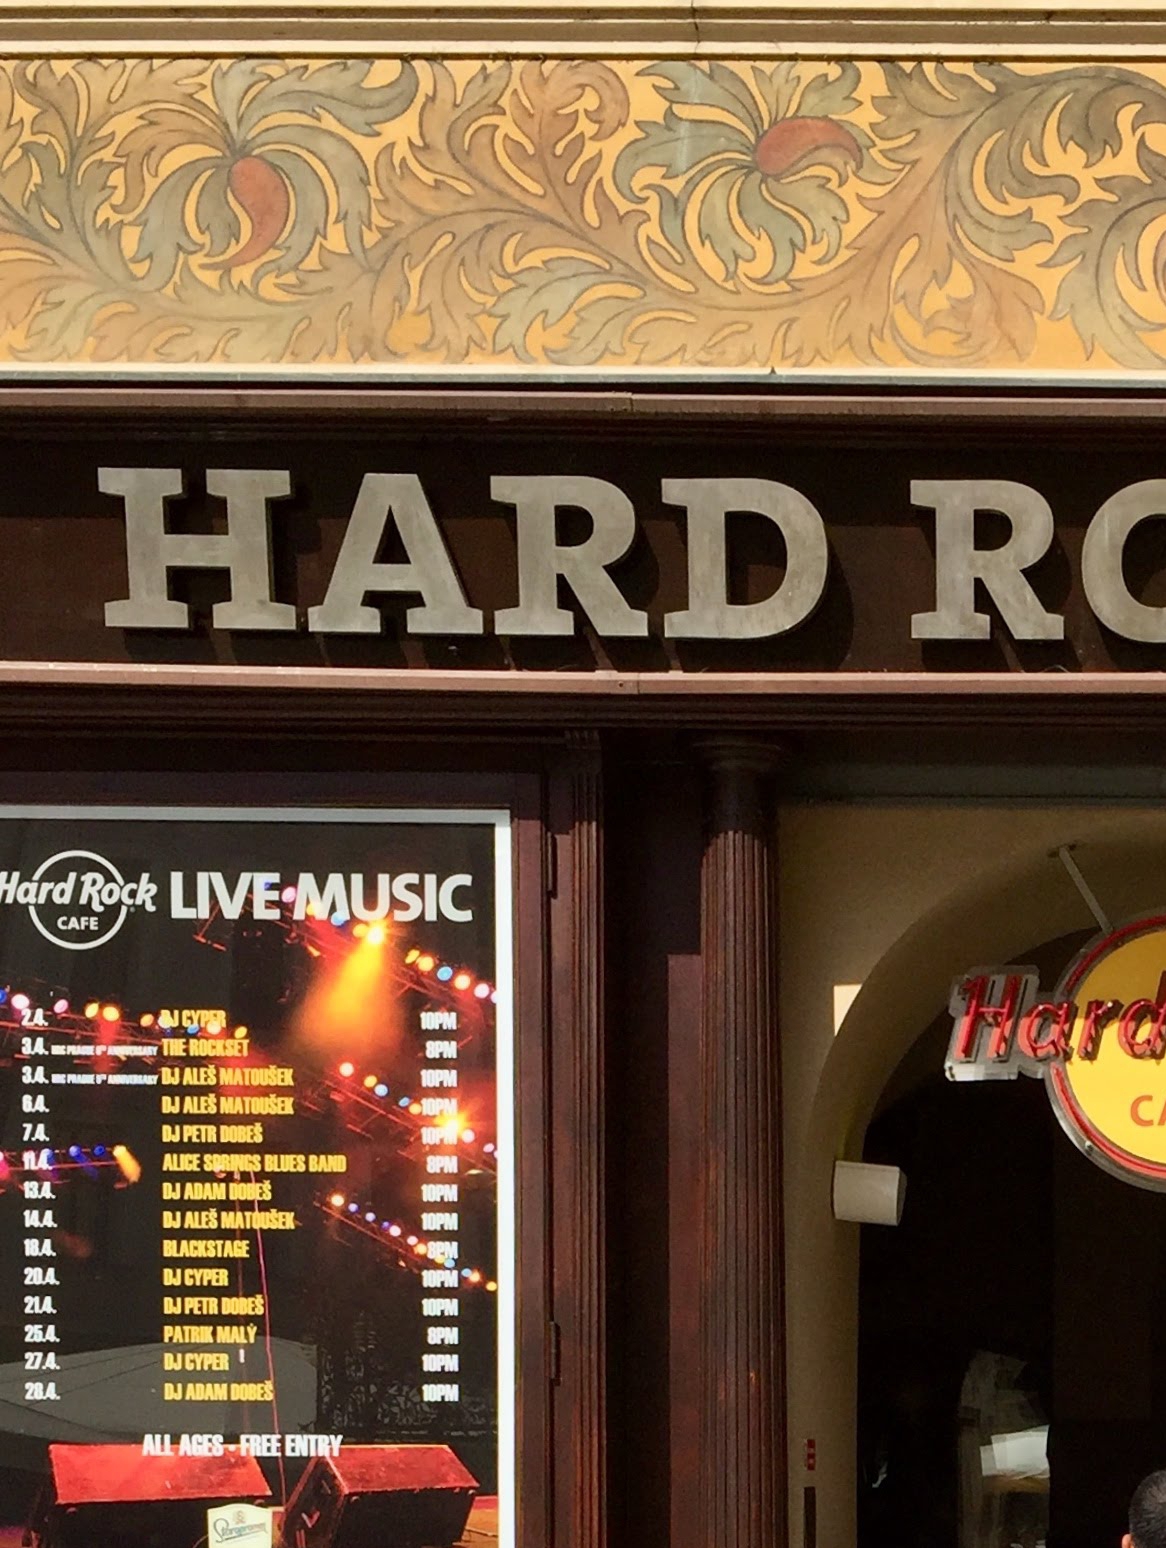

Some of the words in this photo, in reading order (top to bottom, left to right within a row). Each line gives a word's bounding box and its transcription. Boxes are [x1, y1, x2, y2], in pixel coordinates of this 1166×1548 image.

[97, 466, 831, 639] HARD
[0, 871, 77, 904] Hard
[79, 872, 158, 912] Rock
[170, 871, 280, 919] LIVE
[294, 872, 473, 922] MUSIC
[56, 916, 99, 931] CAFE
[21, 1008, 48, 1027] 2.4.
[160, 1010, 179, 1027] DJ
[182, 1010, 226, 1027] CYPER
[420, 1012, 457, 1030] 10PM
[22, 1037, 48, 1055] 3.4.
[162, 1039, 187, 1057] THE
[189, 1039, 249, 1057] ROCKSET
[425, 1041, 458, 1059] 8PM
[22, 1066, 48, 1084] 3.4.
[161, 1067, 180, 1085] DJ
[420, 1069, 458, 1087] 10PM
[22, 1094, 49, 1113] 6.4.
[161, 1096, 180, 1114] DJ
[421, 1098, 458, 1116] 10PM
[22, 1123, 49, 1141] 7.4.
[161, 1125, 180, 1142] DJ
[183, 1125, 217, 1143] PETR
[421, 1127, 458, 1145] 10PM
[163, 1154, 200, 1171] ALICE
[265, 1155, 306, 1172] BLUES
[308, 1155, 347, 1172] BAND
[426, 1155, 459, 1173] 8PM
[23, 1181, 56, 1199] 13.4.
[162, 1183, 181, 1200] DJ
[184, 1183, 226, 1200] ADAM
[421, 1184, 458, 1202] 10PM
[23, 1210, 57, 1228] 14.4.
[163, 1211, 181, 1229] DJ
[421, 1212, 459, 1231] 10PM
[23, 1238, 56, 1257] 18.4.
[163, 1240, 250, 1258] BLACKSTAGE
[426, 1241, 459, 1260] 8PM
[23, 1267, 60, 1285] 20.4.
[163, 1268, 181, 1286] DJ
[184, 1269, 228, 1286] CYPER
[421, 1269, 459, 1288] 10PM
[24, 1296, 57, 1314] 21.4.
[163, 1297, 181, 1314] DJ
[184, 1297, 218, 1315] PETR
[422, 1298, 459, 1317] 10PM
[24, 1325, 60, 1343] 25.4.
[163, 1326, 214, 1343] PATRIK
[427, 1327, 459, 1345] 8PM
[24, 1352, 60, 1370] 27.4.
[164, 1353, 181, 1370] DJ
[184, 1353, 230, 1371] CYPER
[422, 1354, 459, 1373] 10PM
[24, 1382, 61, 1400] 28.4.
[164, 1383, 182, 1400] DJ
[185, 1383, 228, 1400] ADAM
[422, 1384, 459, 1402] 10PM
[142, 1433, 174, 1456] ALL
[178, 1433, 224, 1457] AGES
[239, 1434, 281, 1457] FREE
[285, 1434, 343, 1457] ENTRY
